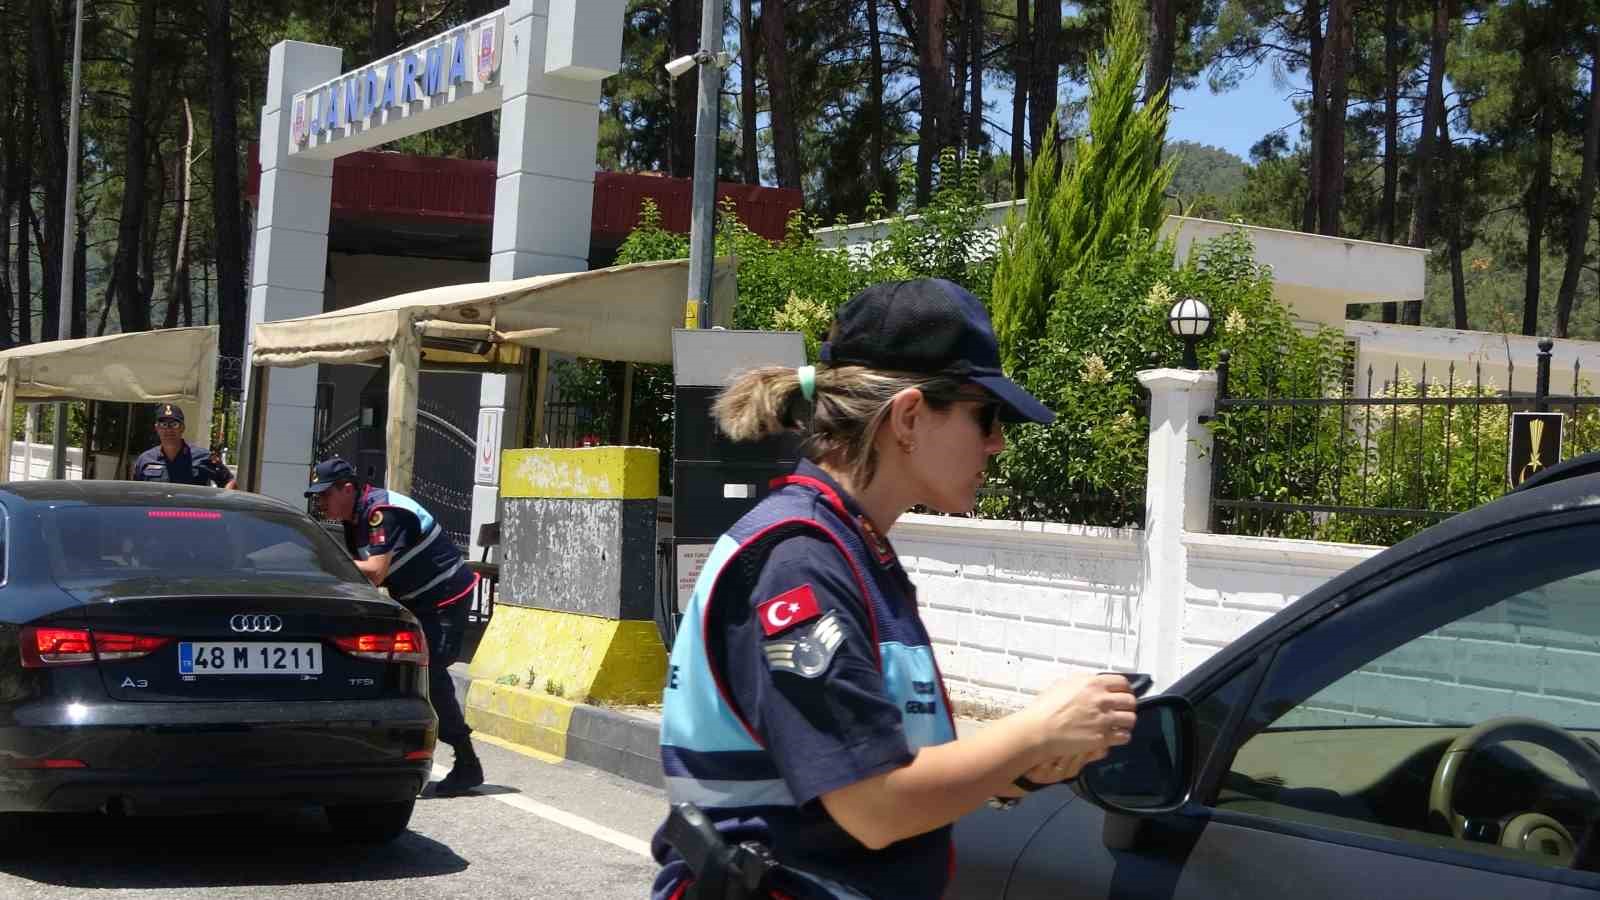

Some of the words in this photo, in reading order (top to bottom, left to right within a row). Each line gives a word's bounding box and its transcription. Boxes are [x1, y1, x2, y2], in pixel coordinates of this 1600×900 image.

[309, 33, 468, 135] JANDARMA
[195, 646, 225, 669] 48
[234, 646, 249, 668] M
[261, 647, 315, 670] 1211
[121, 677, 148, 688] A3
